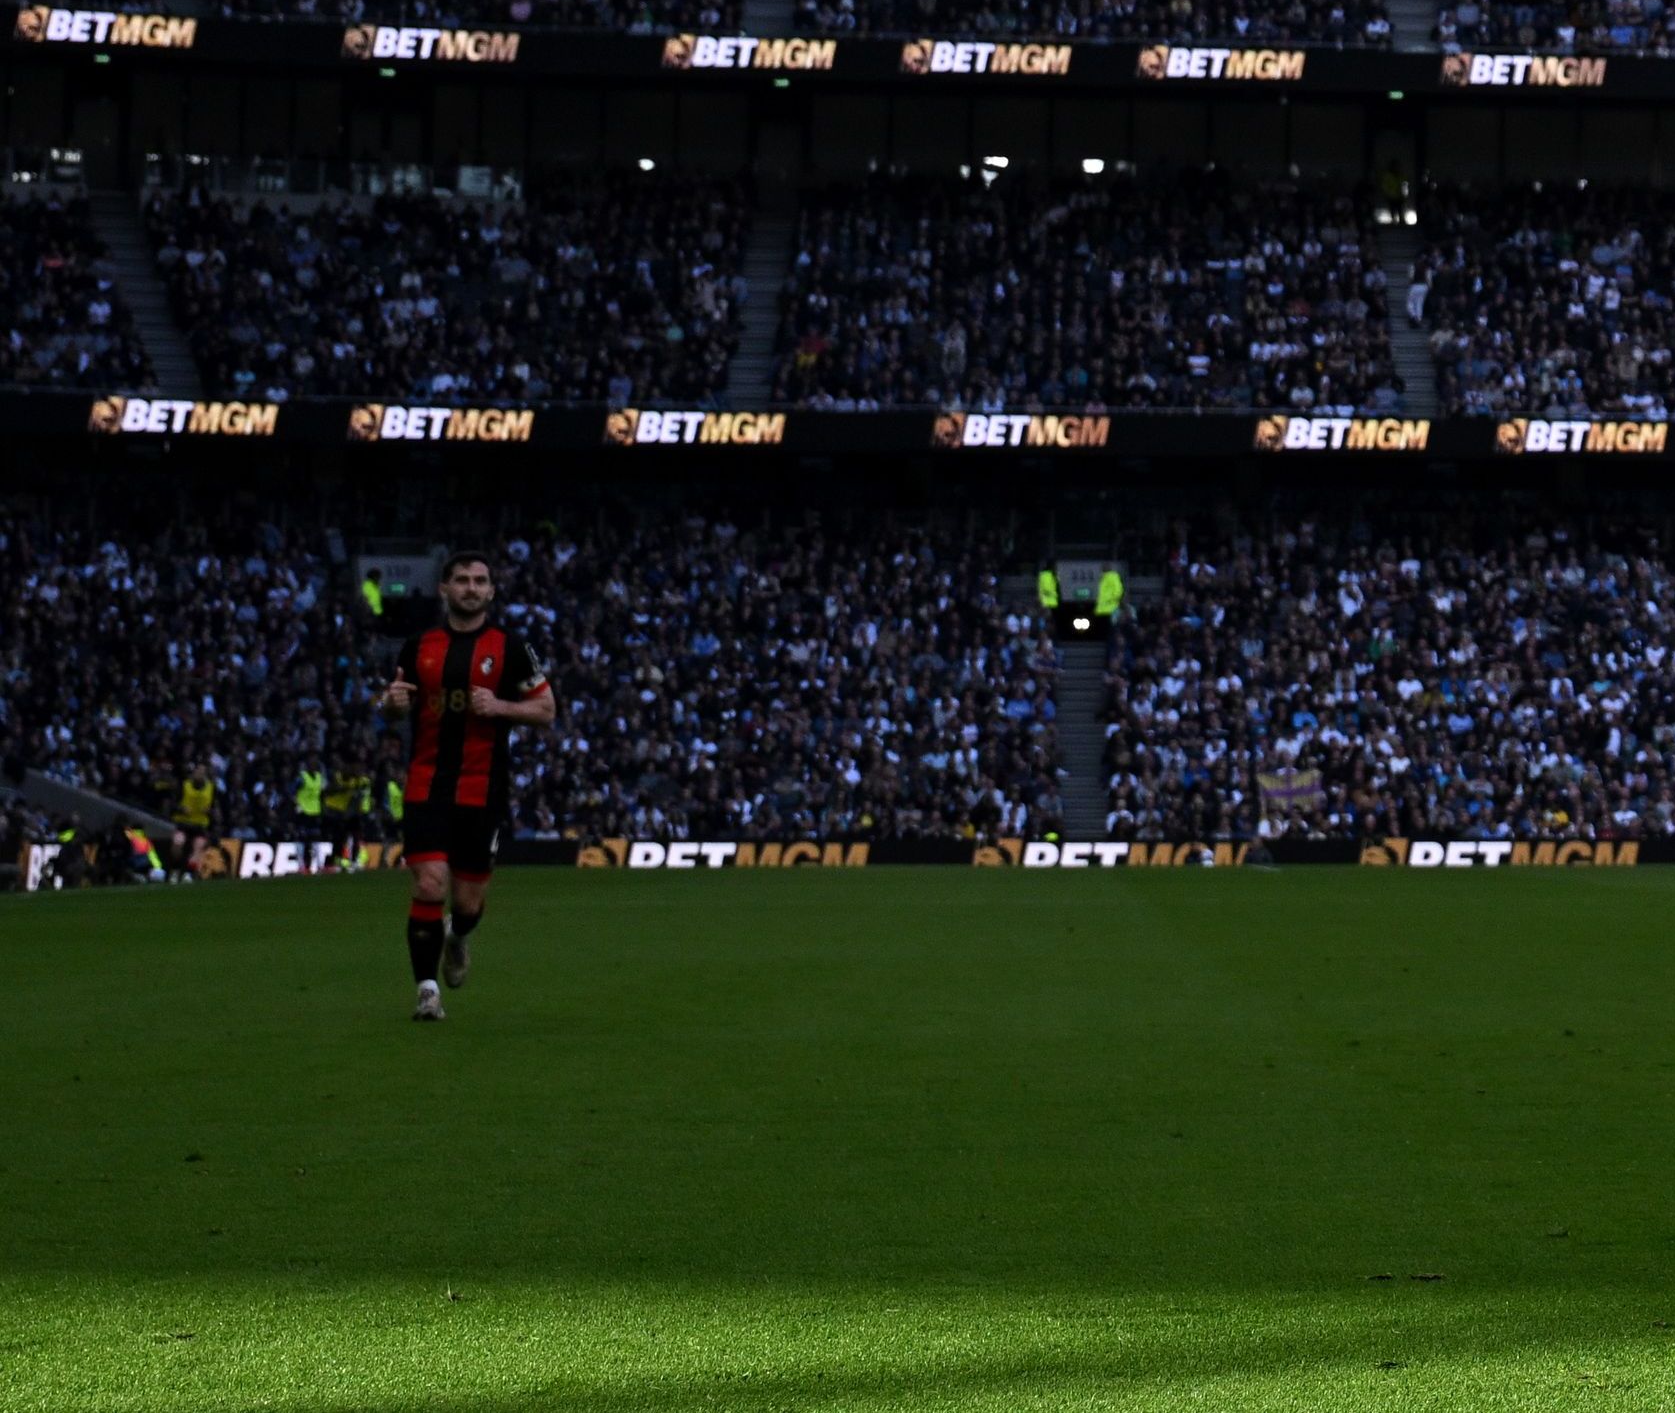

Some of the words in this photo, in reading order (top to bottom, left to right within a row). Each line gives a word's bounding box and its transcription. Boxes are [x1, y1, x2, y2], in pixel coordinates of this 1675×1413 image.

[46, 11, 197, 48] BETMGM
[373, 27, 520, 62] BETMGM
[693, 37, 837, 70] BETMGM
[931, 42, 1071, 74] BETMGM
[1167, 47, 1305, 80] BETMGM
[1470, 54, 1607, 86] BETMGM
[120, 399, 279, 435] BETMGM
[382, 406, 533, 441] BETMGM
[636, 411, 787, 445] BETMGM
[963, 414, 1111, 447] BETMGM
[1284, 417, 1430, 450] BETMGM
[1525, 420, 1668, 453] BETMGM
